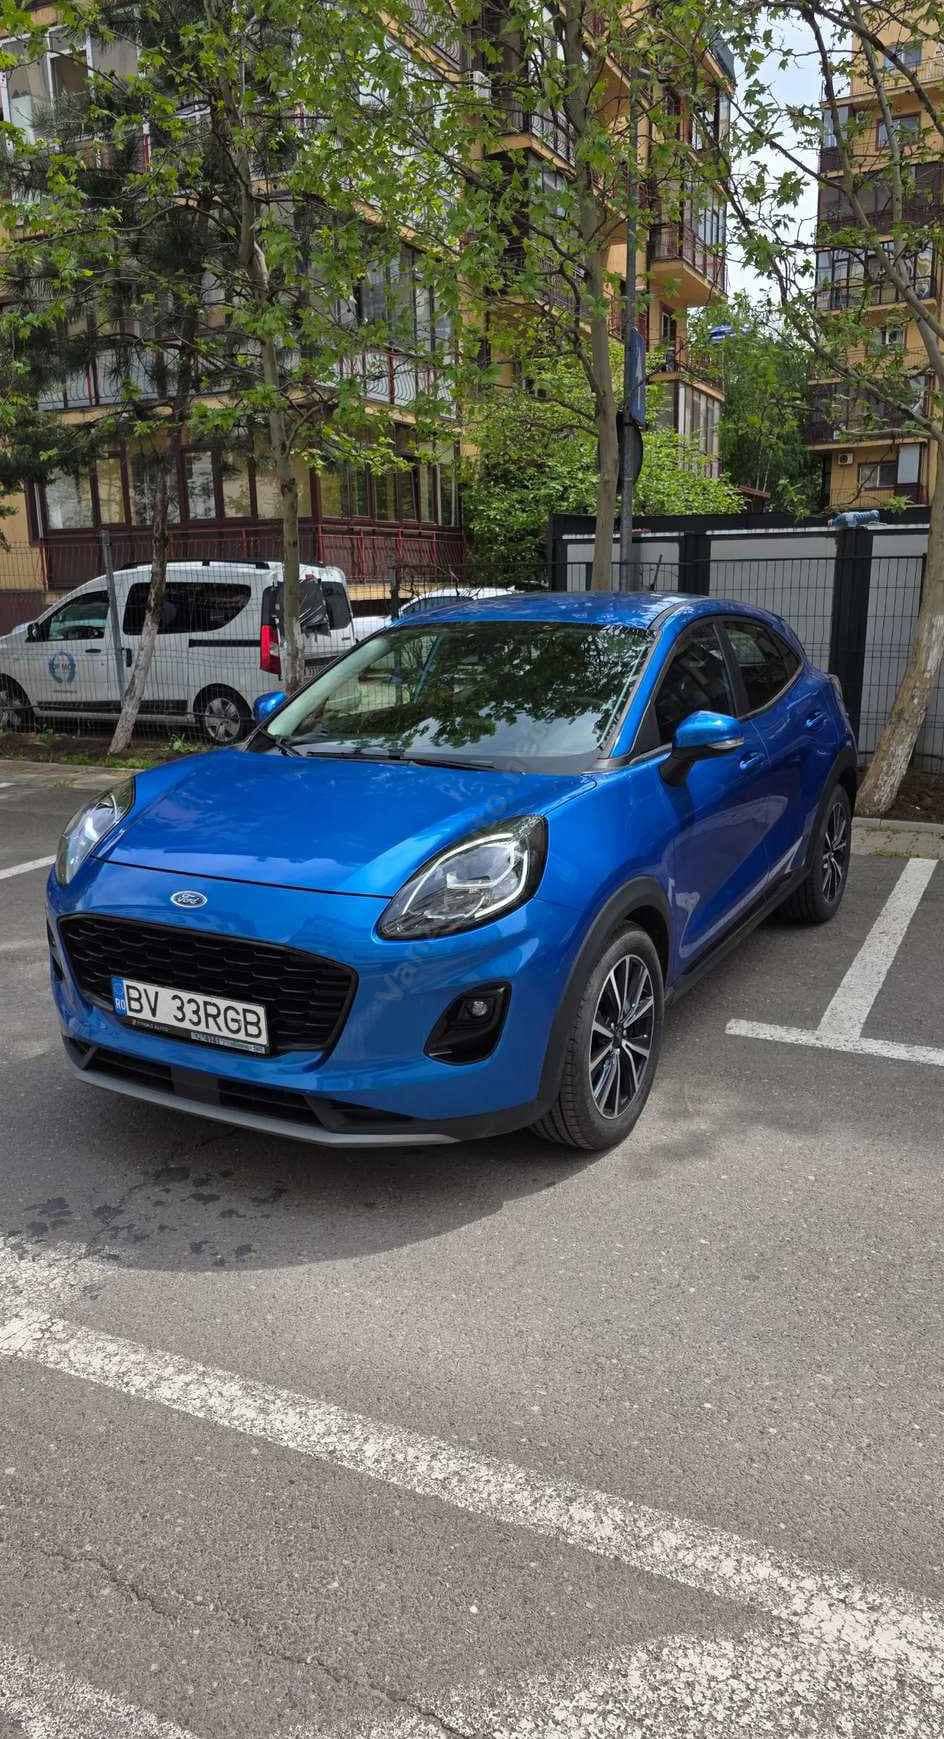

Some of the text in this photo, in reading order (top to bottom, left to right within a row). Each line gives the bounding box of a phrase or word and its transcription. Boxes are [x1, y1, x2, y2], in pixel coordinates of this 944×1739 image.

[115, 998, 126, 1010] RO
[126, 985, 262, 1039] BV 33RGB
